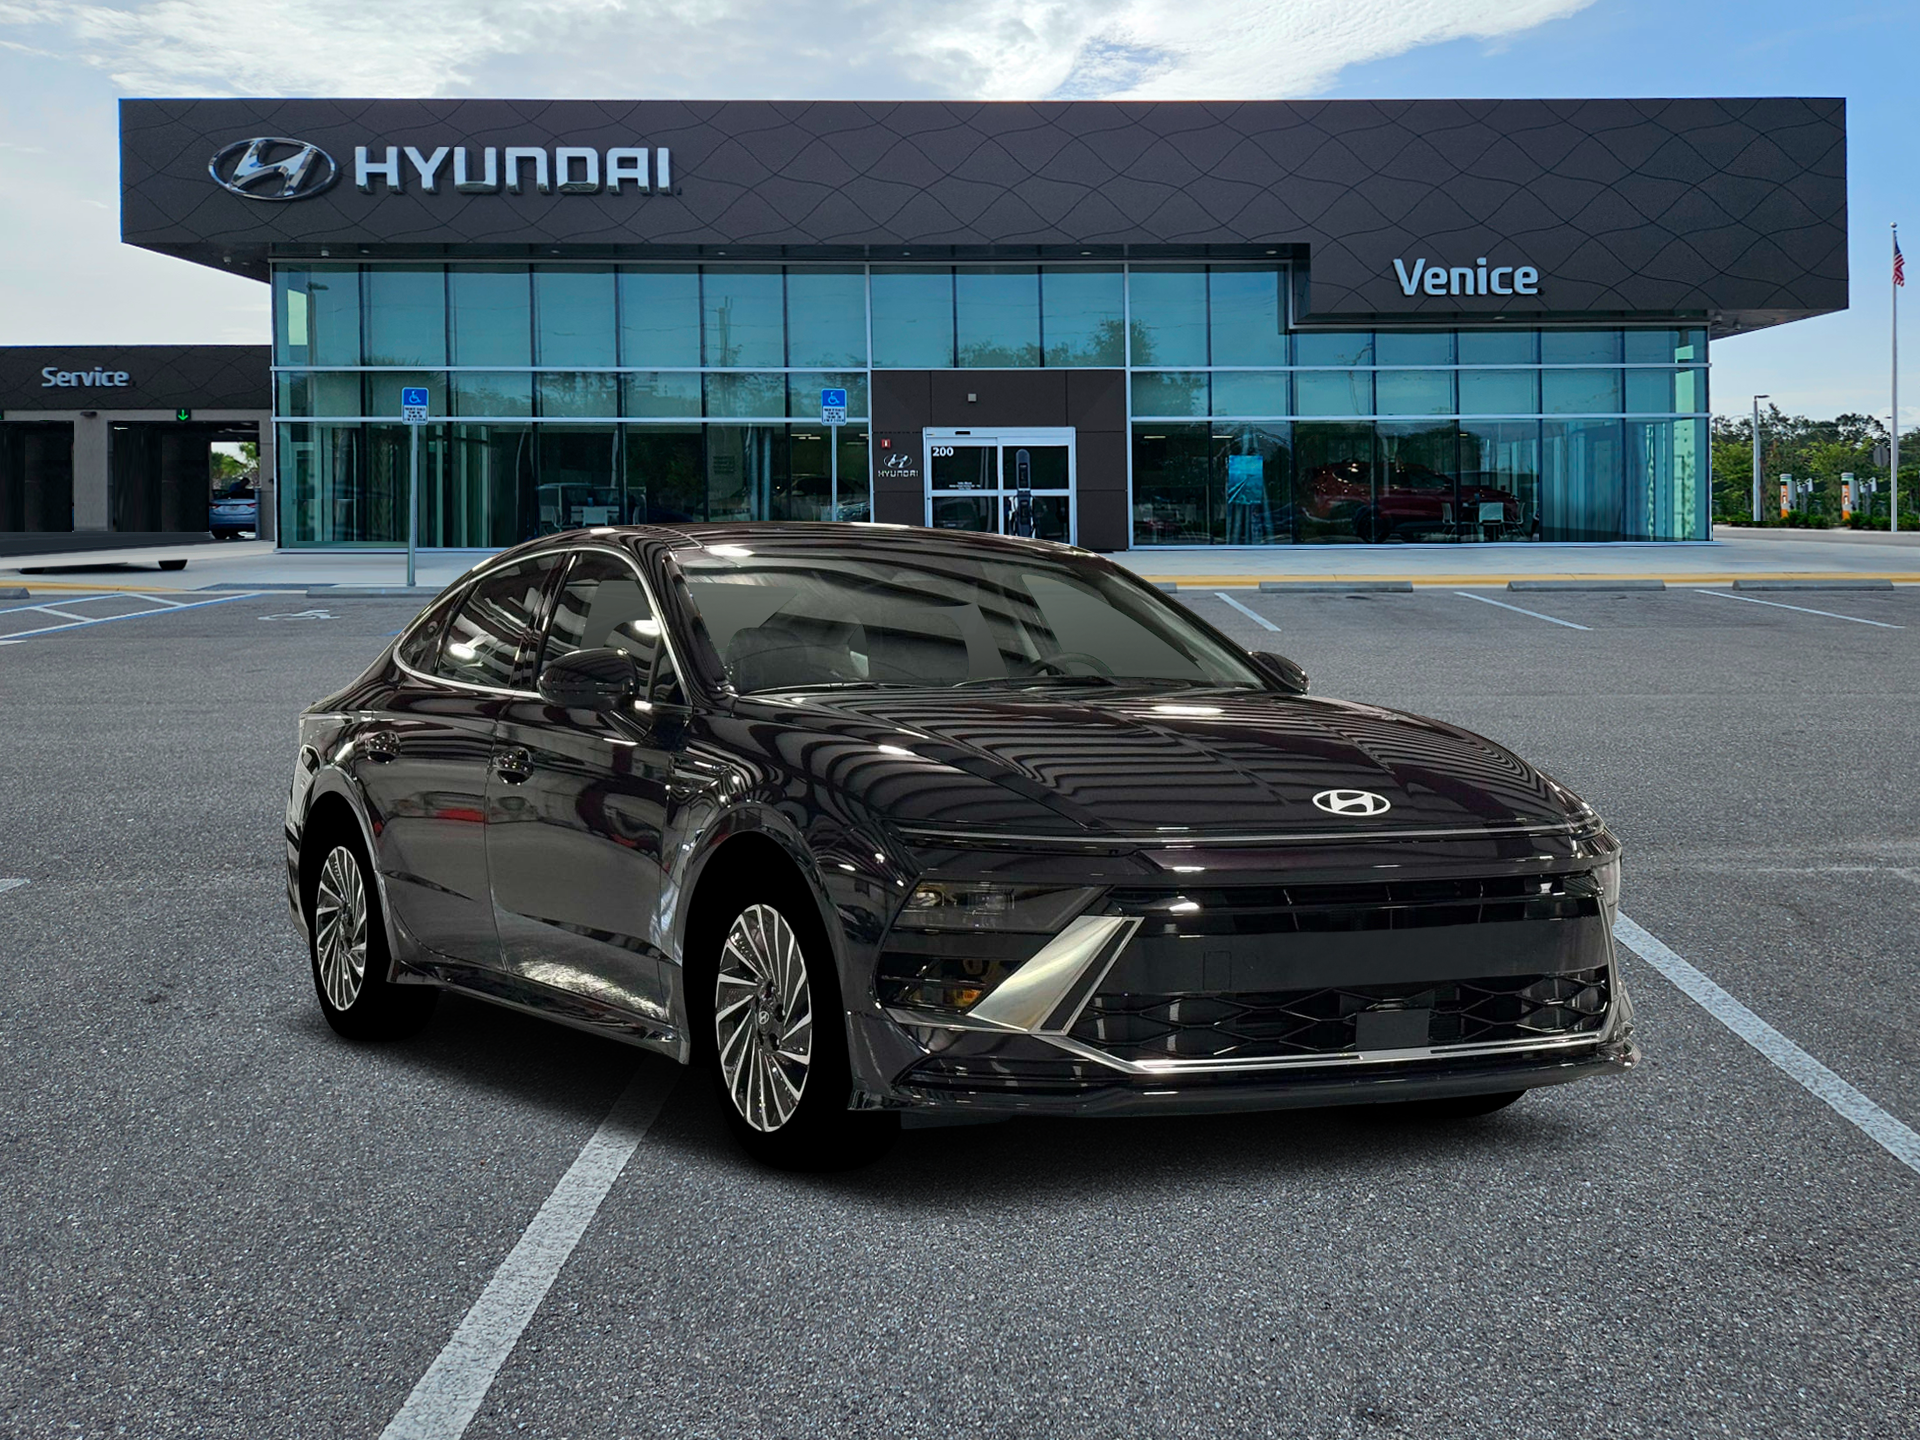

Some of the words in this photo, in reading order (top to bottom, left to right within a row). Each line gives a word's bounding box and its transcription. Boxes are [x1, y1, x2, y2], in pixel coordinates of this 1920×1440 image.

[354, 146, 671, 194] HYUNDAI
[1393, 257, 1539, 296] Venice
[41, 366, 130, 387] Service
[932, 447, 954, 457] 200
[877, 469, 919, 478] HYUNDAI
